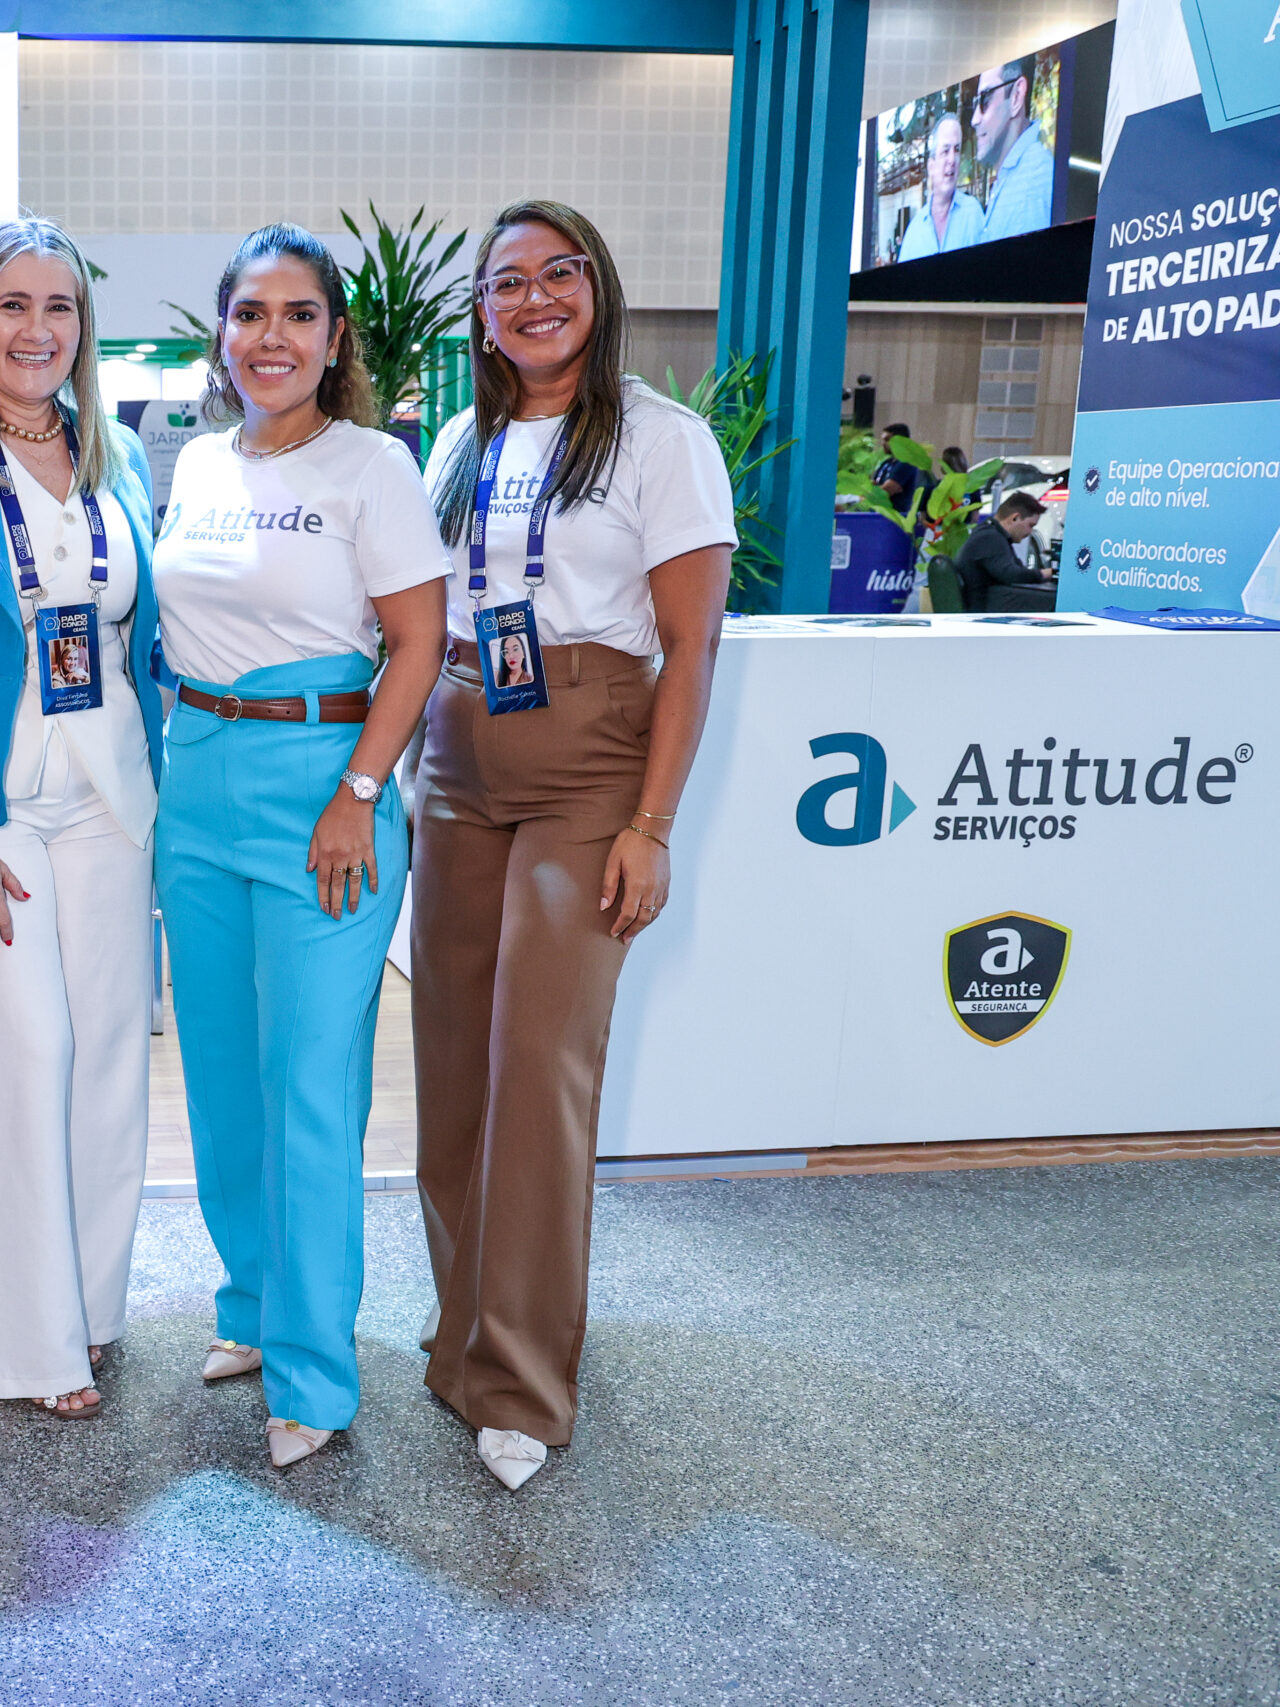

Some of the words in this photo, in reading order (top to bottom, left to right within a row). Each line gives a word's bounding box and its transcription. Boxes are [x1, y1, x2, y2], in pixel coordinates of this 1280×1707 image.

[1109, 209, 1184, 249] NOSSA
[1190, 188, 1280, 230] SOLUÇ
[1103, 317, 1129, 343] DE
[1132, 301, 1213, 344] ALTO
[1108, 458, 1163, 485] Equipe
[1105, 487, 1126, 507] de
[1130, 488, 1162, 507] alto
[1165, 486, 1211, 509] nível.
[192, 505, 323, 534] Atitude
[488, 502, 529, 517] RVIÇOS
[12, 525, 20, 548] PAPO
[183, 530, 245, 544] SERVIÇOS
[1100, 539, 1227, 565] Colaboradores
[1097, 565, 1203, 593] Qualificados.
[61, 613, 88, 623] PAPO
[61, 620, 88, 628] CONDO
[499, 611, 525, 621] PAPO
[500, 618, 526, 628] CONDO
[933, 814, 1077, 848] SERVIÇOS
[963, 981, 1042, 998] Atente
[971, 1003, 1028, 1012] SEGURANÇA
